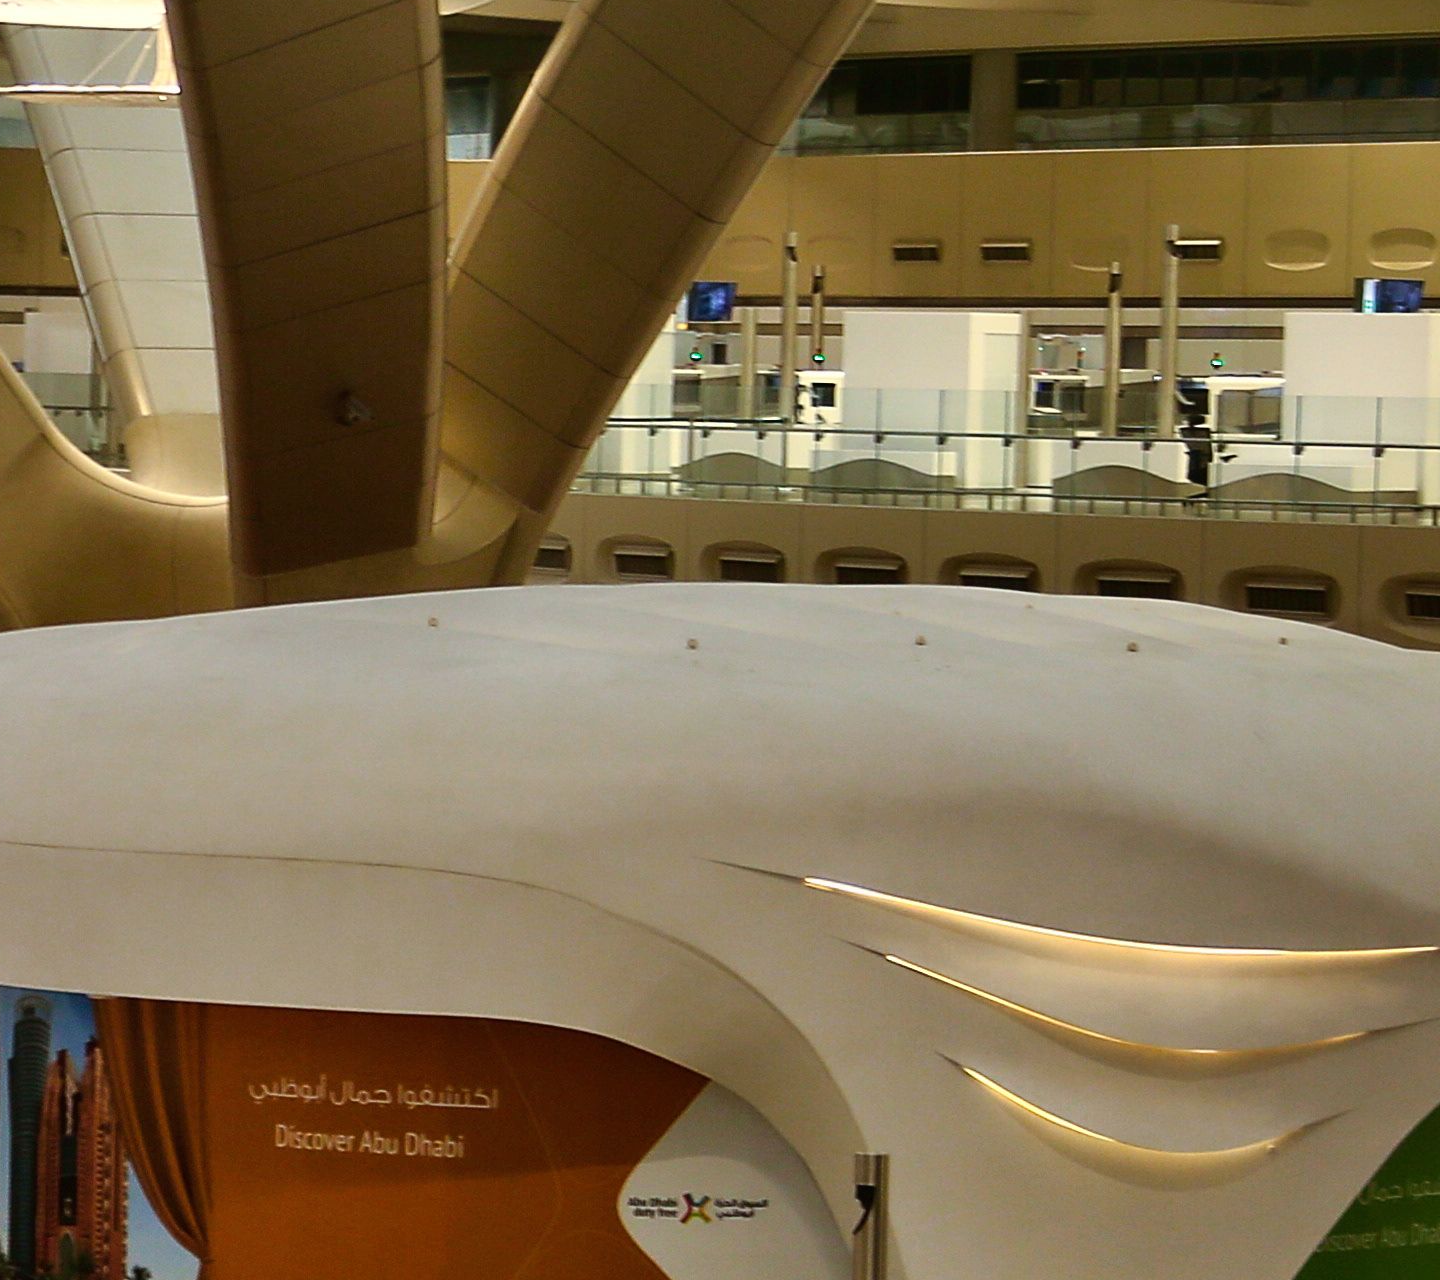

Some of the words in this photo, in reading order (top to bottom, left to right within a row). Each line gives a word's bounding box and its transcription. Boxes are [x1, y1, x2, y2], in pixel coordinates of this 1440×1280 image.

[329, 1080, 392, 1107] جمال
[397, 1084, 499, 1110] اكتشفوا
[274, 1123, 355, 1154] Discover
[359, 1129, 399, 1156] Abu
[405, 1132, 464, 1159] Dhabi
